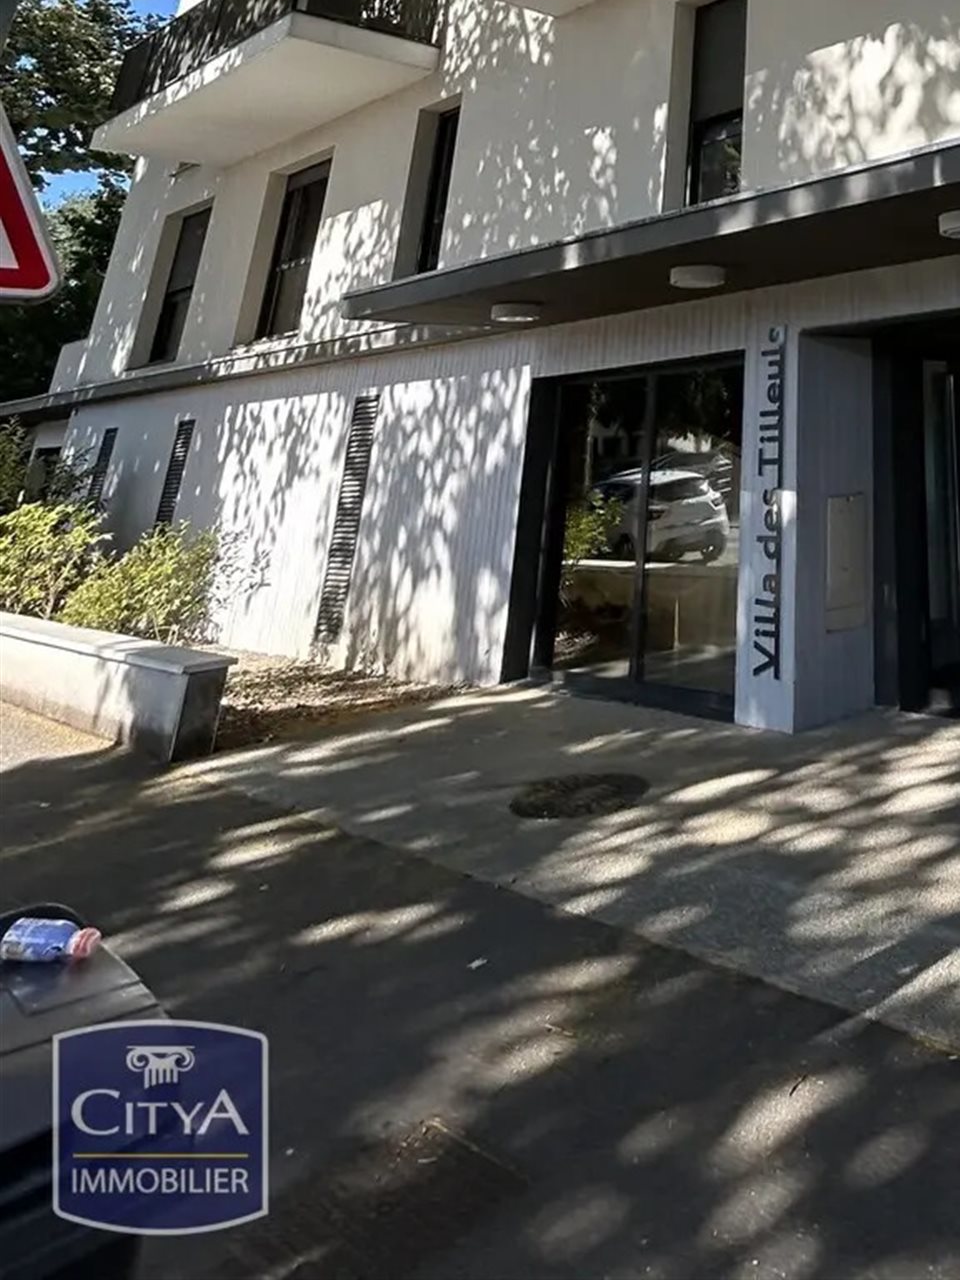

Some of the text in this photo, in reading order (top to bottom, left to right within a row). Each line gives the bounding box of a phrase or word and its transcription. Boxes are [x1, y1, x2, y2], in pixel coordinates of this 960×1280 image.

[753, 327, 782, 677] Villa des Tilleuls
